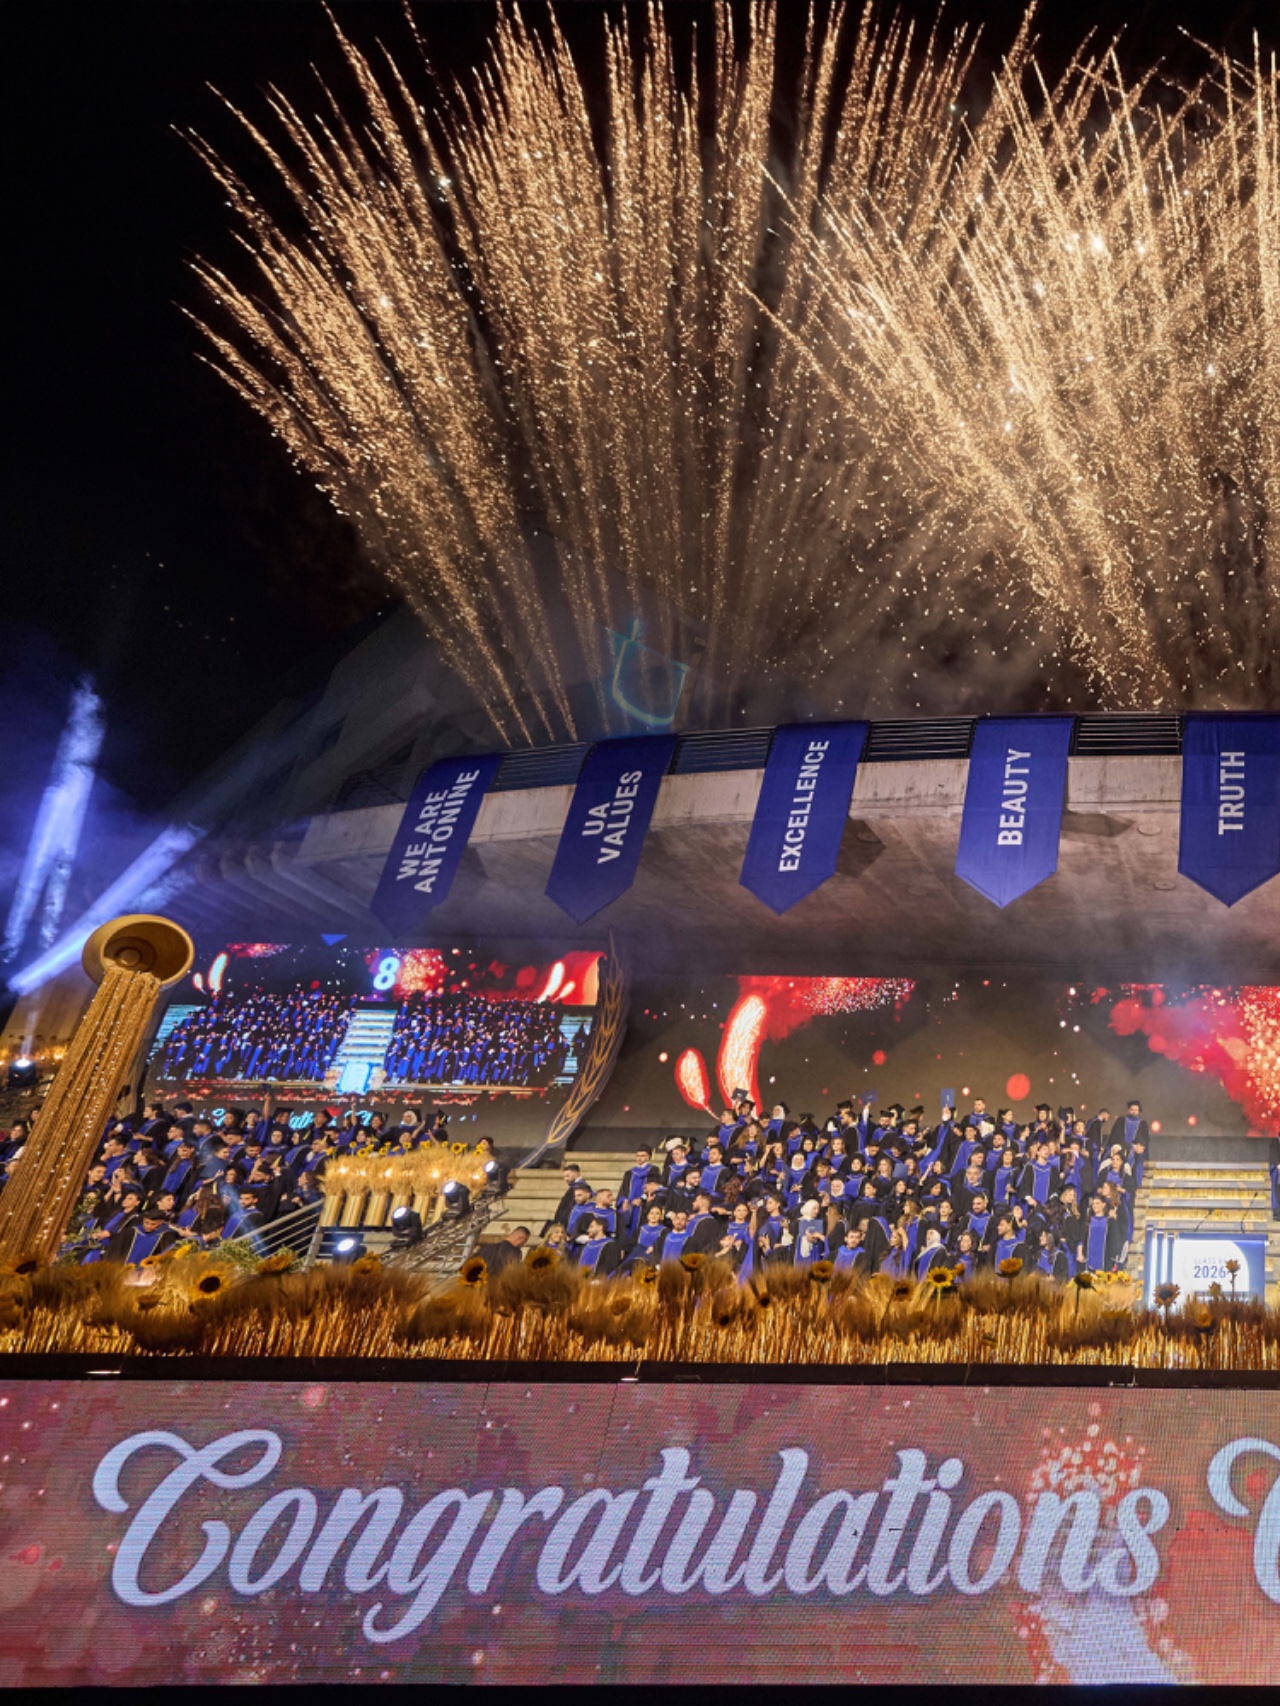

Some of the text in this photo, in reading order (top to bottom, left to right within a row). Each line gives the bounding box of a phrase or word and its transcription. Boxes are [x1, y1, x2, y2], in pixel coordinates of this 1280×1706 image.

[396, 789, 449, 880] WE ARE
[414, 769, 480, 893] ANTONINE
[582, 802, 610, 836] UA
[597, 770, 643, 864] VALUES
[779, 739, 830, 872] EXCELLENCE
[997, 748, 1031, 846] BEAUTY
[1218, 751, 1245, 835] TRUTH
[373, 956, 400, 990] 8
[1194, 1265, 1226, 1279] 2026
[93, 1430, 1170, 1643] Congratulations
